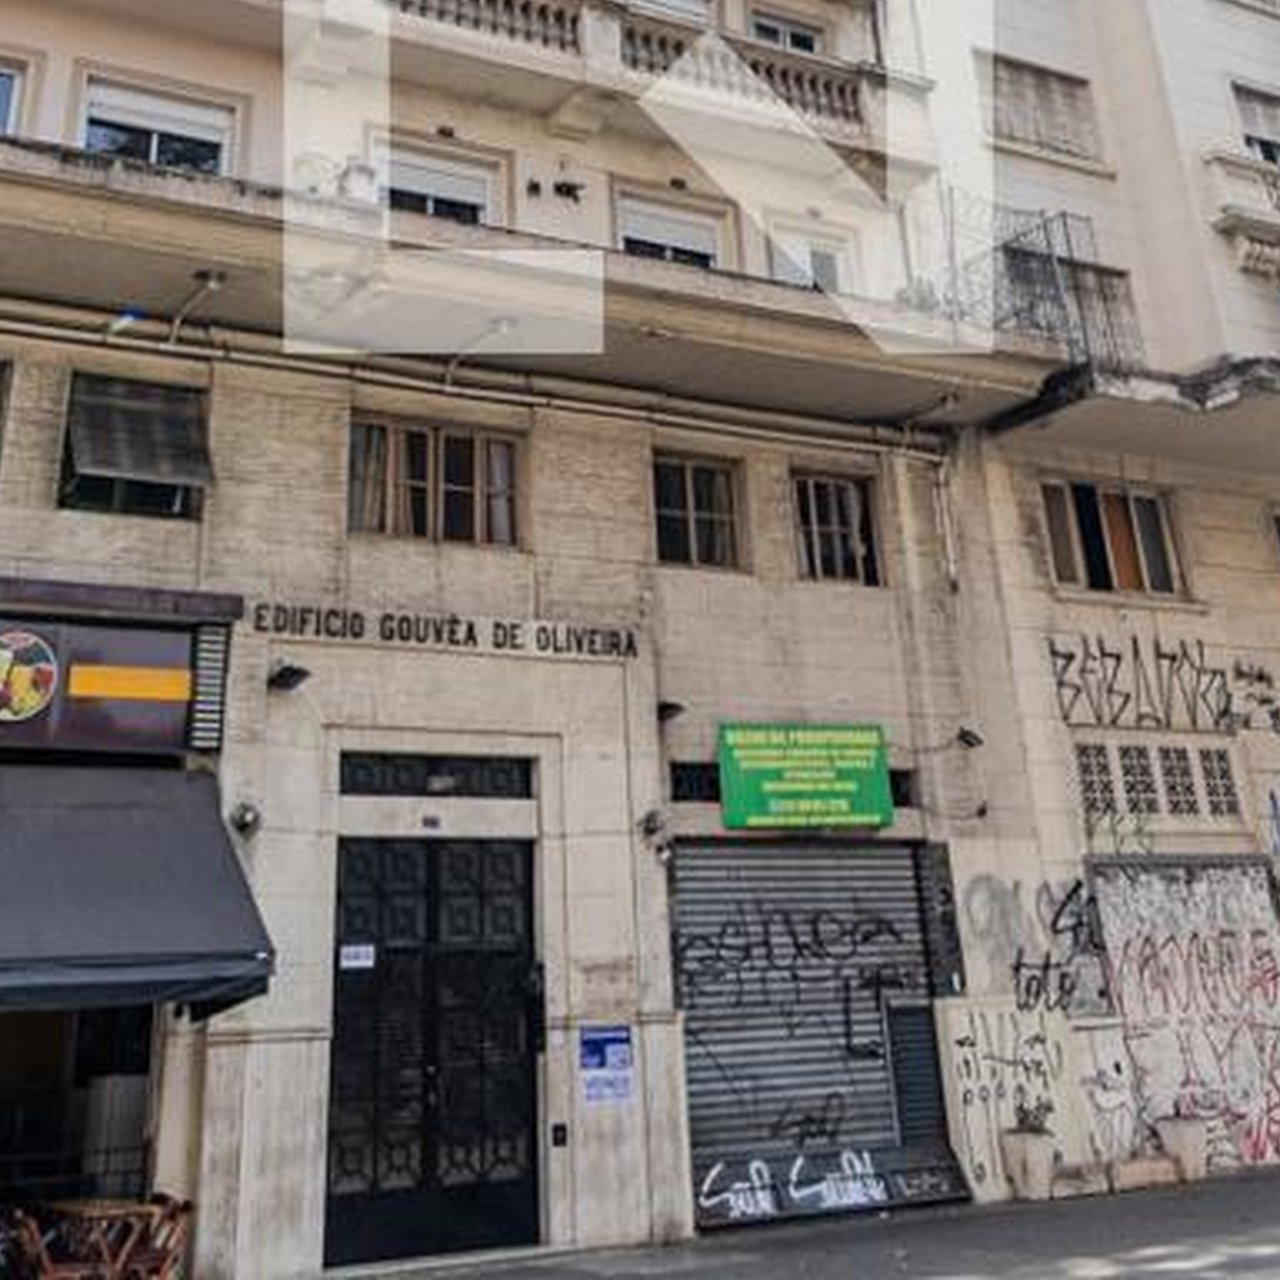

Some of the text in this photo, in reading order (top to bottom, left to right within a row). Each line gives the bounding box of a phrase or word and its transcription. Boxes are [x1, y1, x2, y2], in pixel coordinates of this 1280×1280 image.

[253, 603, 365, 640] EDIFICIO
[492, 621, 521, 651] DE
[536, 626, 639, 658] OLIVEIRA
